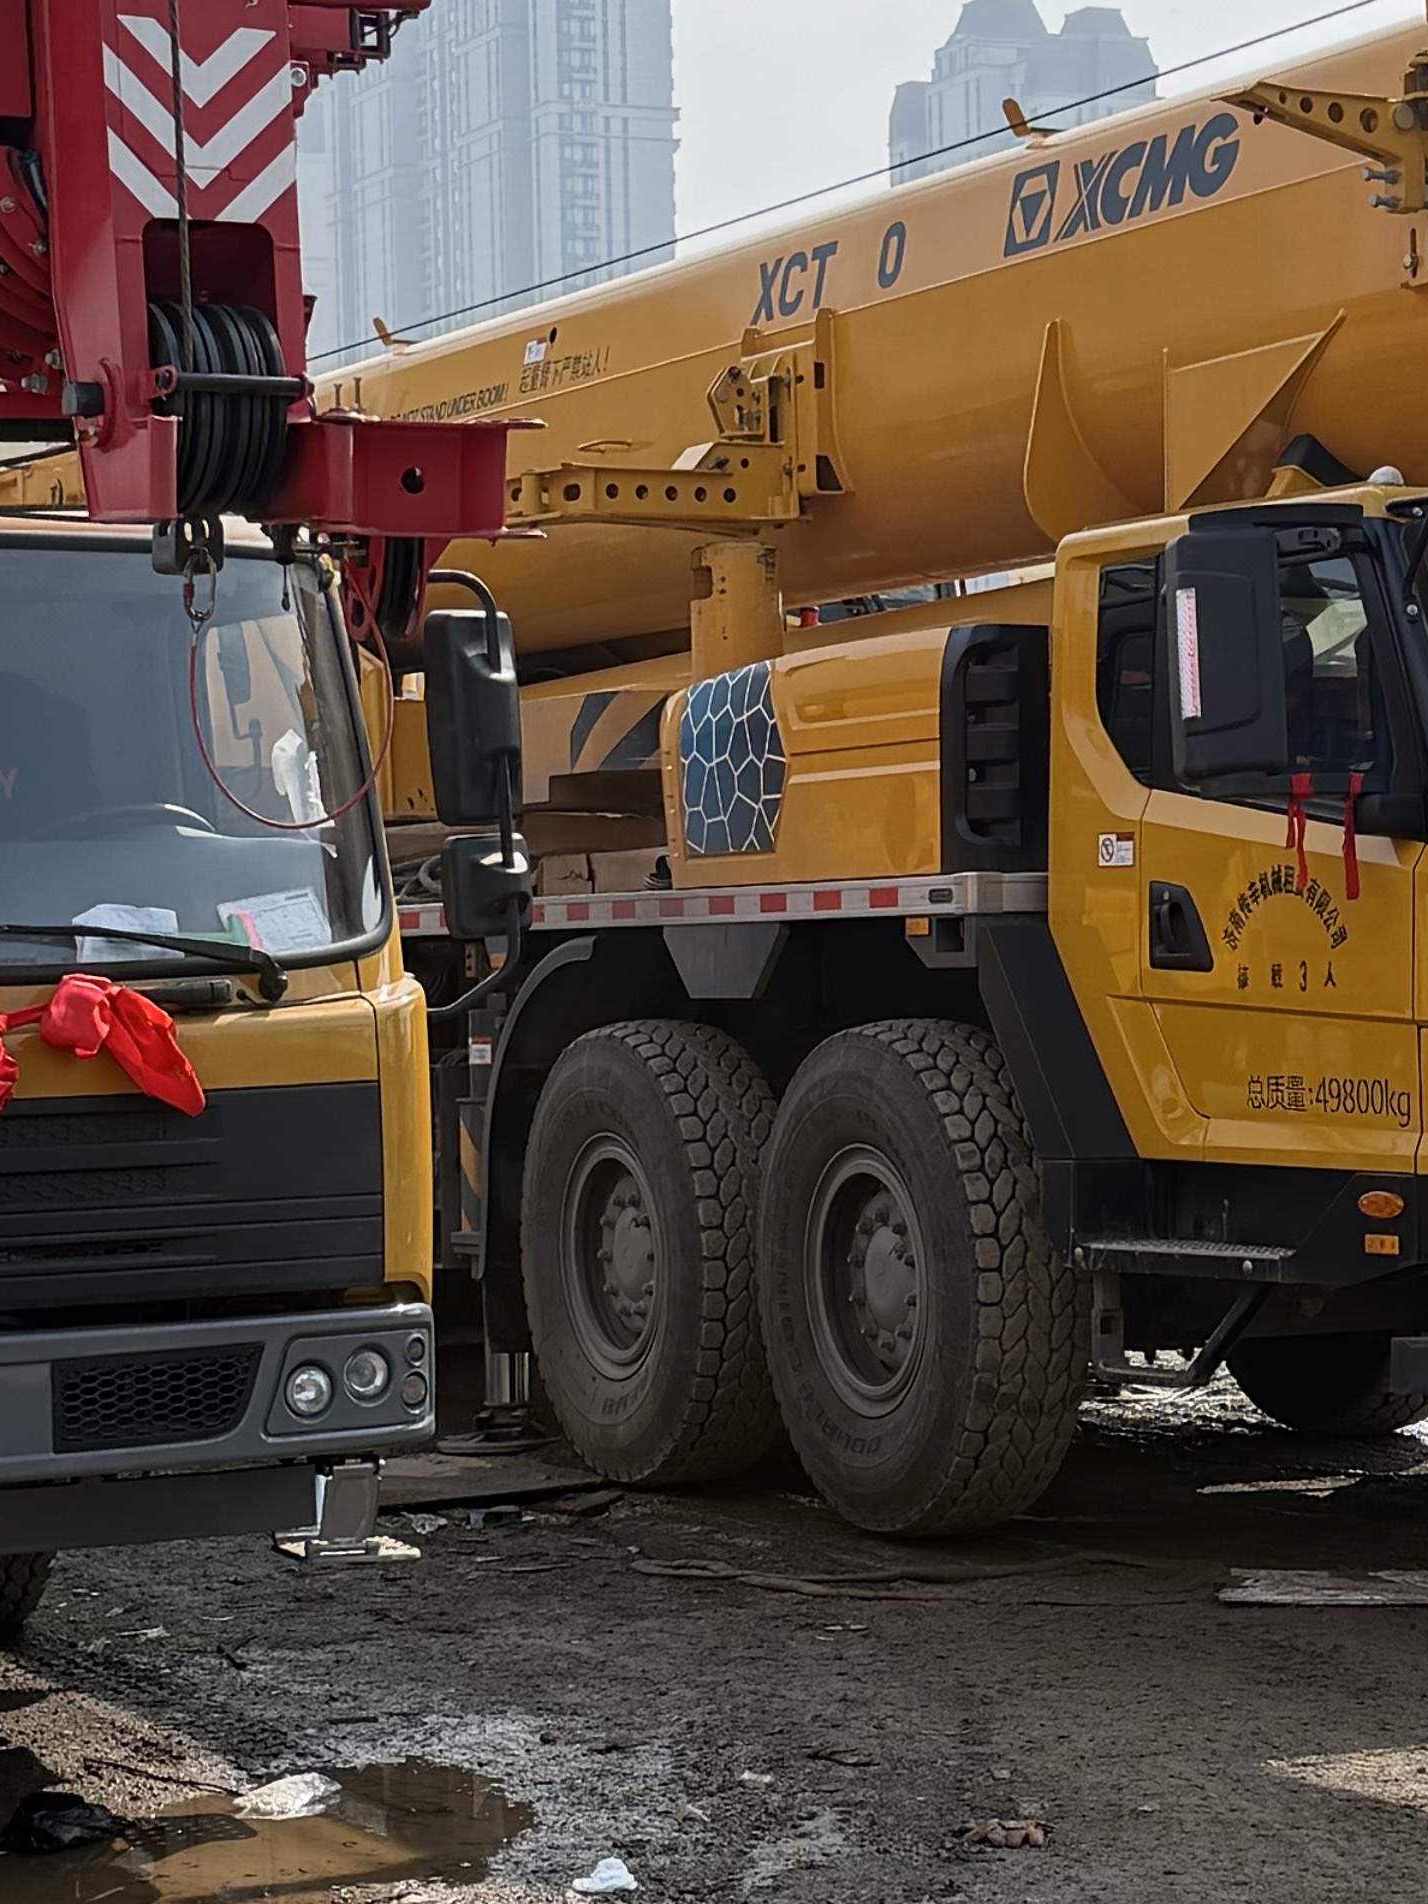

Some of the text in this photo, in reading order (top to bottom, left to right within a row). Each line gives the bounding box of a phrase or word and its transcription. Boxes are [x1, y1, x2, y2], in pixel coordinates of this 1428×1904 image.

[1053, 113, 1240, 243] XCMG
[750, 240, 839, 326] XCT
[447, 392, 477, 417] UNDER
[1247, 1075, 1411, 1128] 总质量:49800kg
